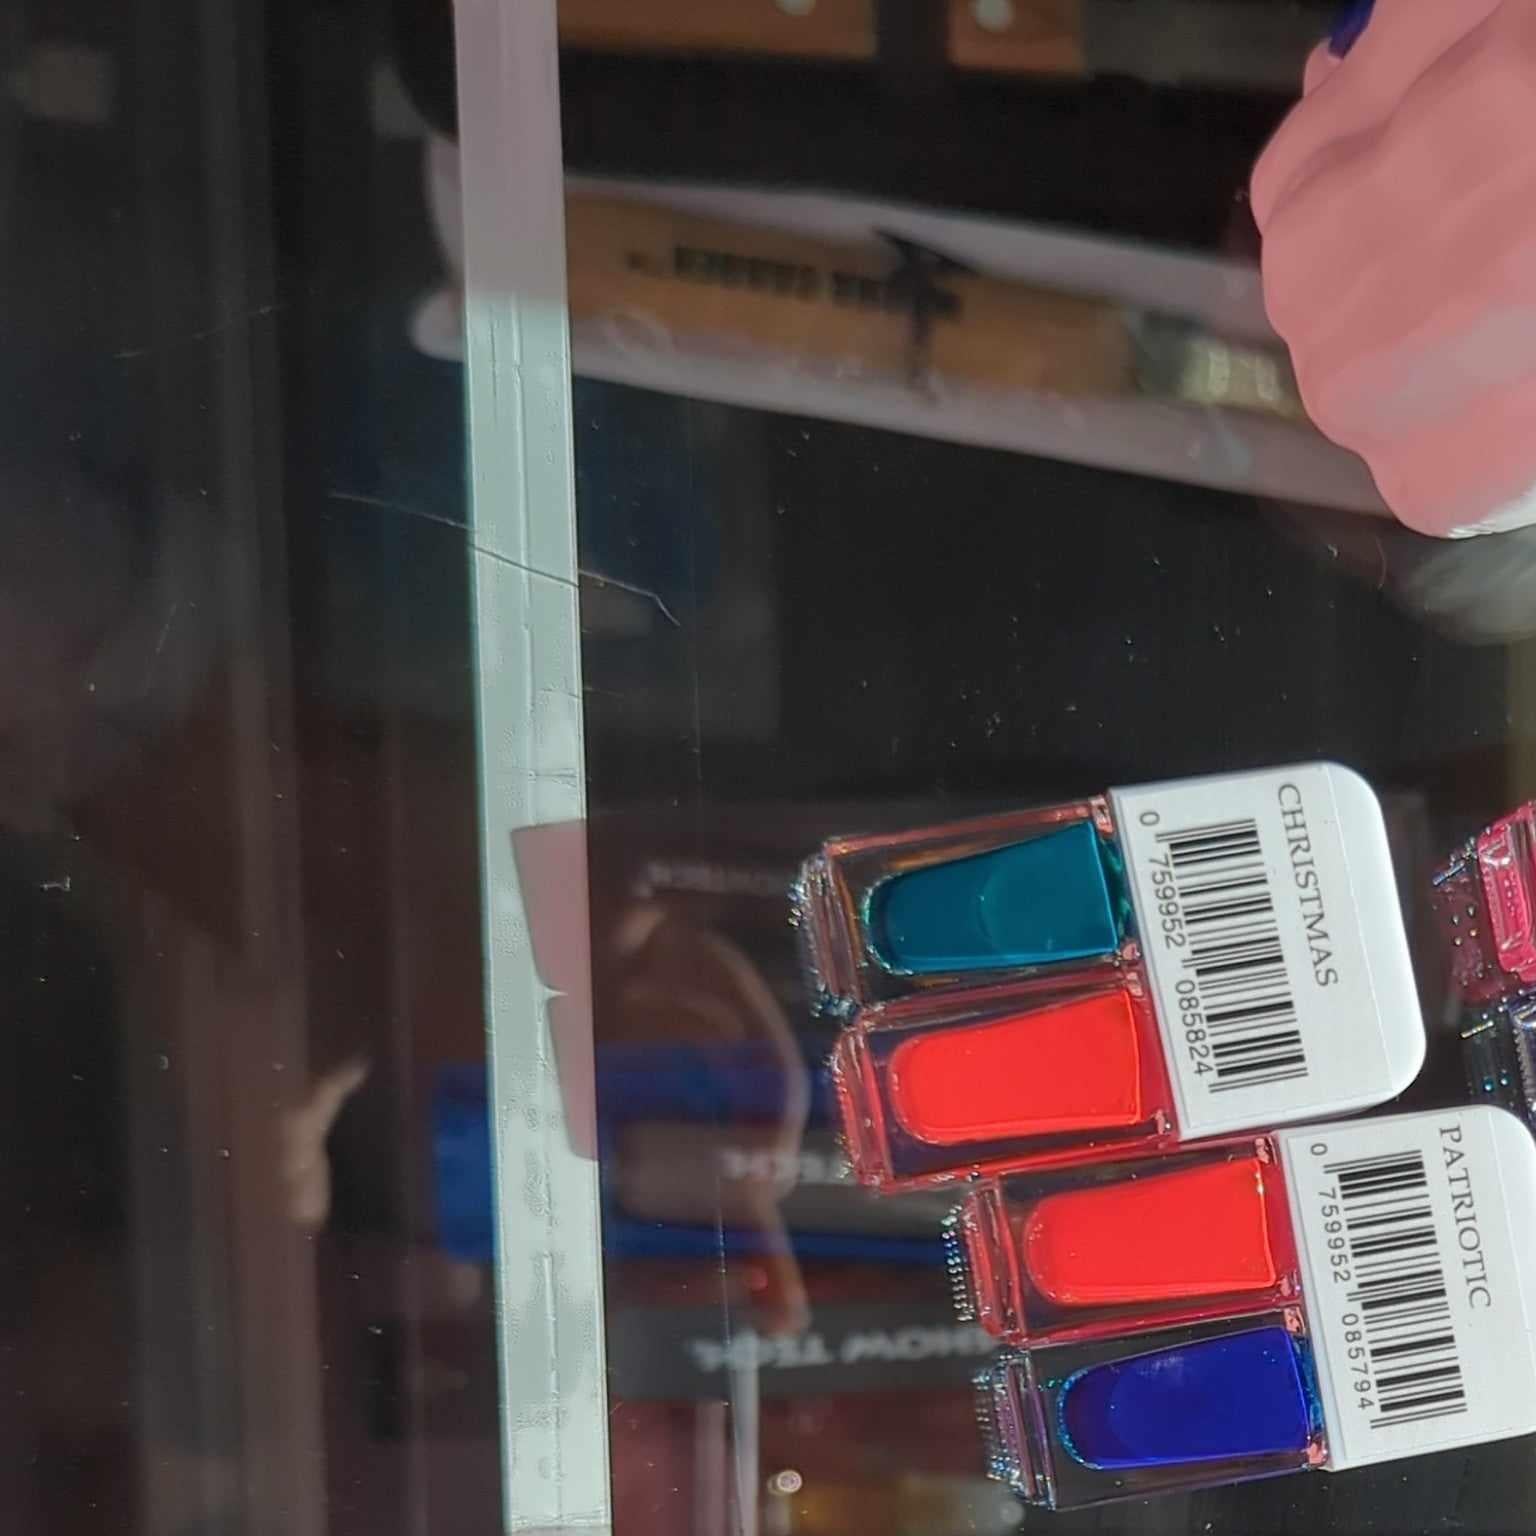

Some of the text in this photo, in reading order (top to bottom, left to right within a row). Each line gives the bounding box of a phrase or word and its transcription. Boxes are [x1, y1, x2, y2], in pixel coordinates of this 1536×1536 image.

[1138, 810, 1214, 1076] 0 759952 085824
[1276, 782, 1339, 987] CHRISTMAS
[1310, 1142, 1375, 1411] 0 759952 085794
[1438, 1123, 1492, 1309] PATRIOTIC
